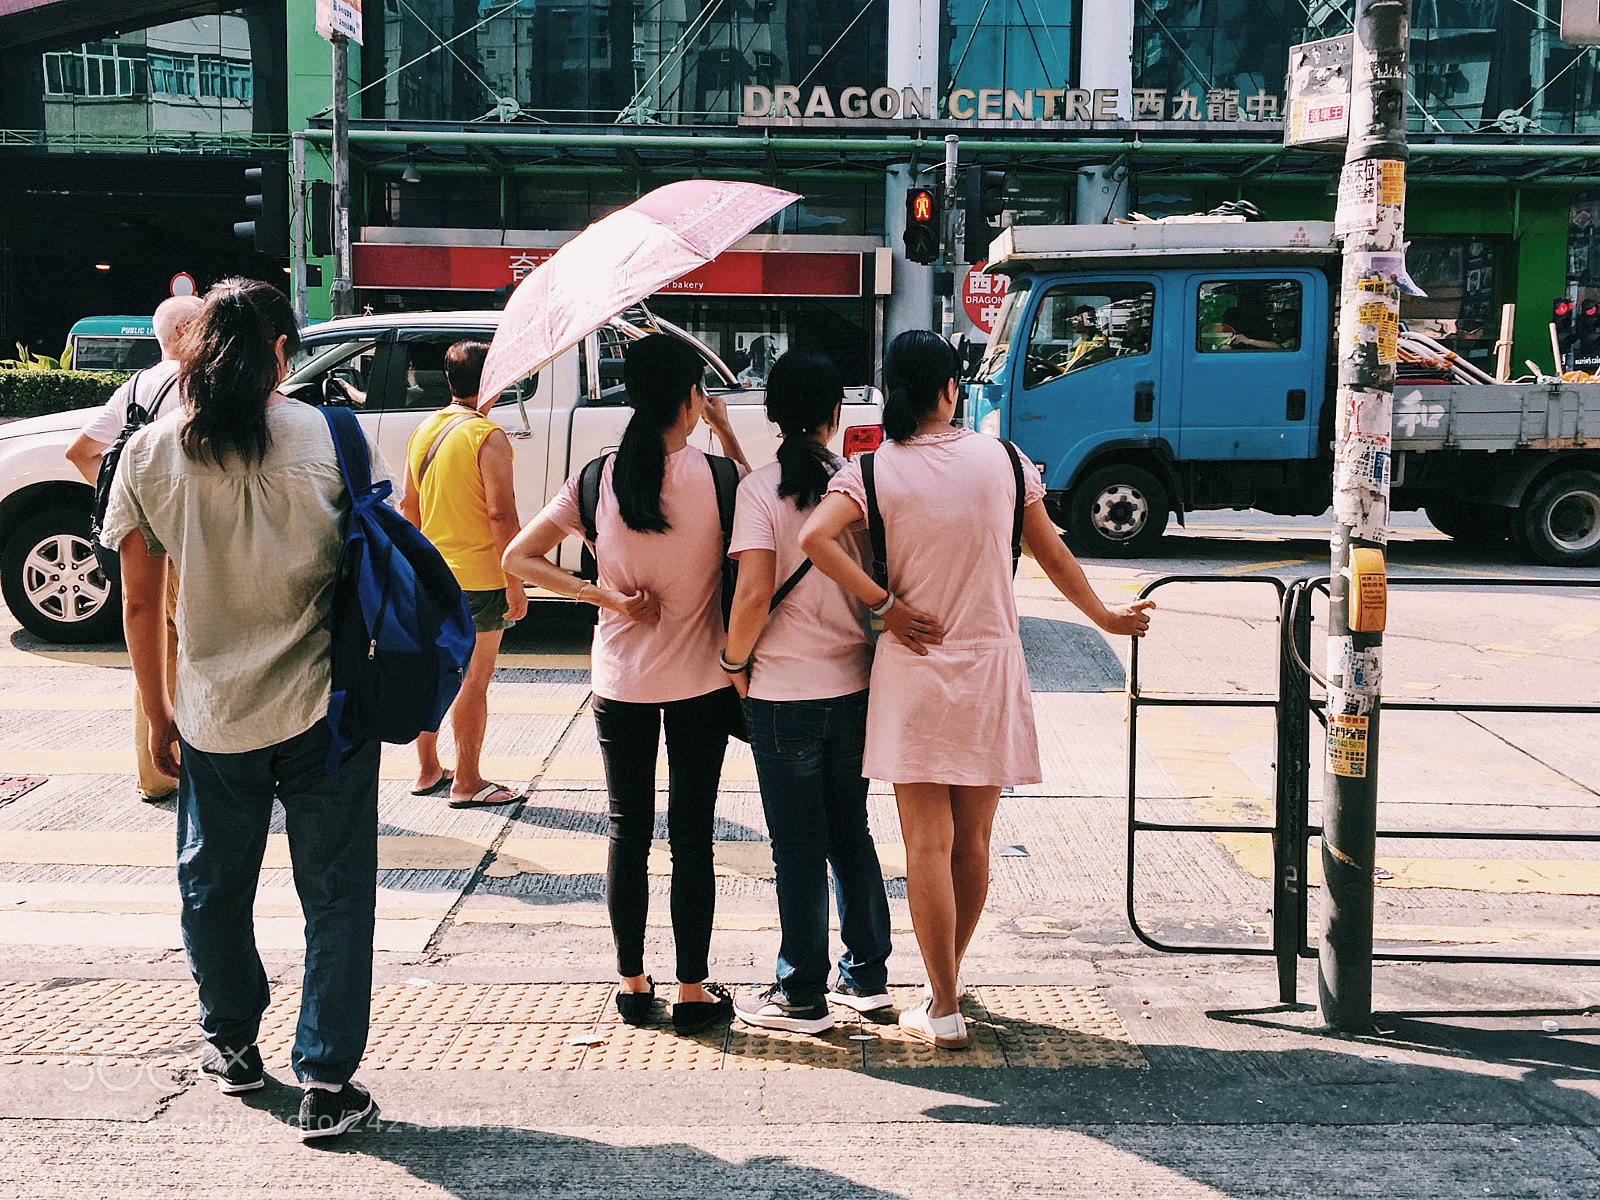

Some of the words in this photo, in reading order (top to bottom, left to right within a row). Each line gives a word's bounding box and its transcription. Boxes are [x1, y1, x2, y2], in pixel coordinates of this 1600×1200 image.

[743, 85, 932, 119] DRAGON
[949, 88, 1119, 121] CENTRE
[1132, 88, 1286, 121] 西九龍中
[672, 281, 704, 291] bakery
[965, 296, 1004, 304] DRAGON
